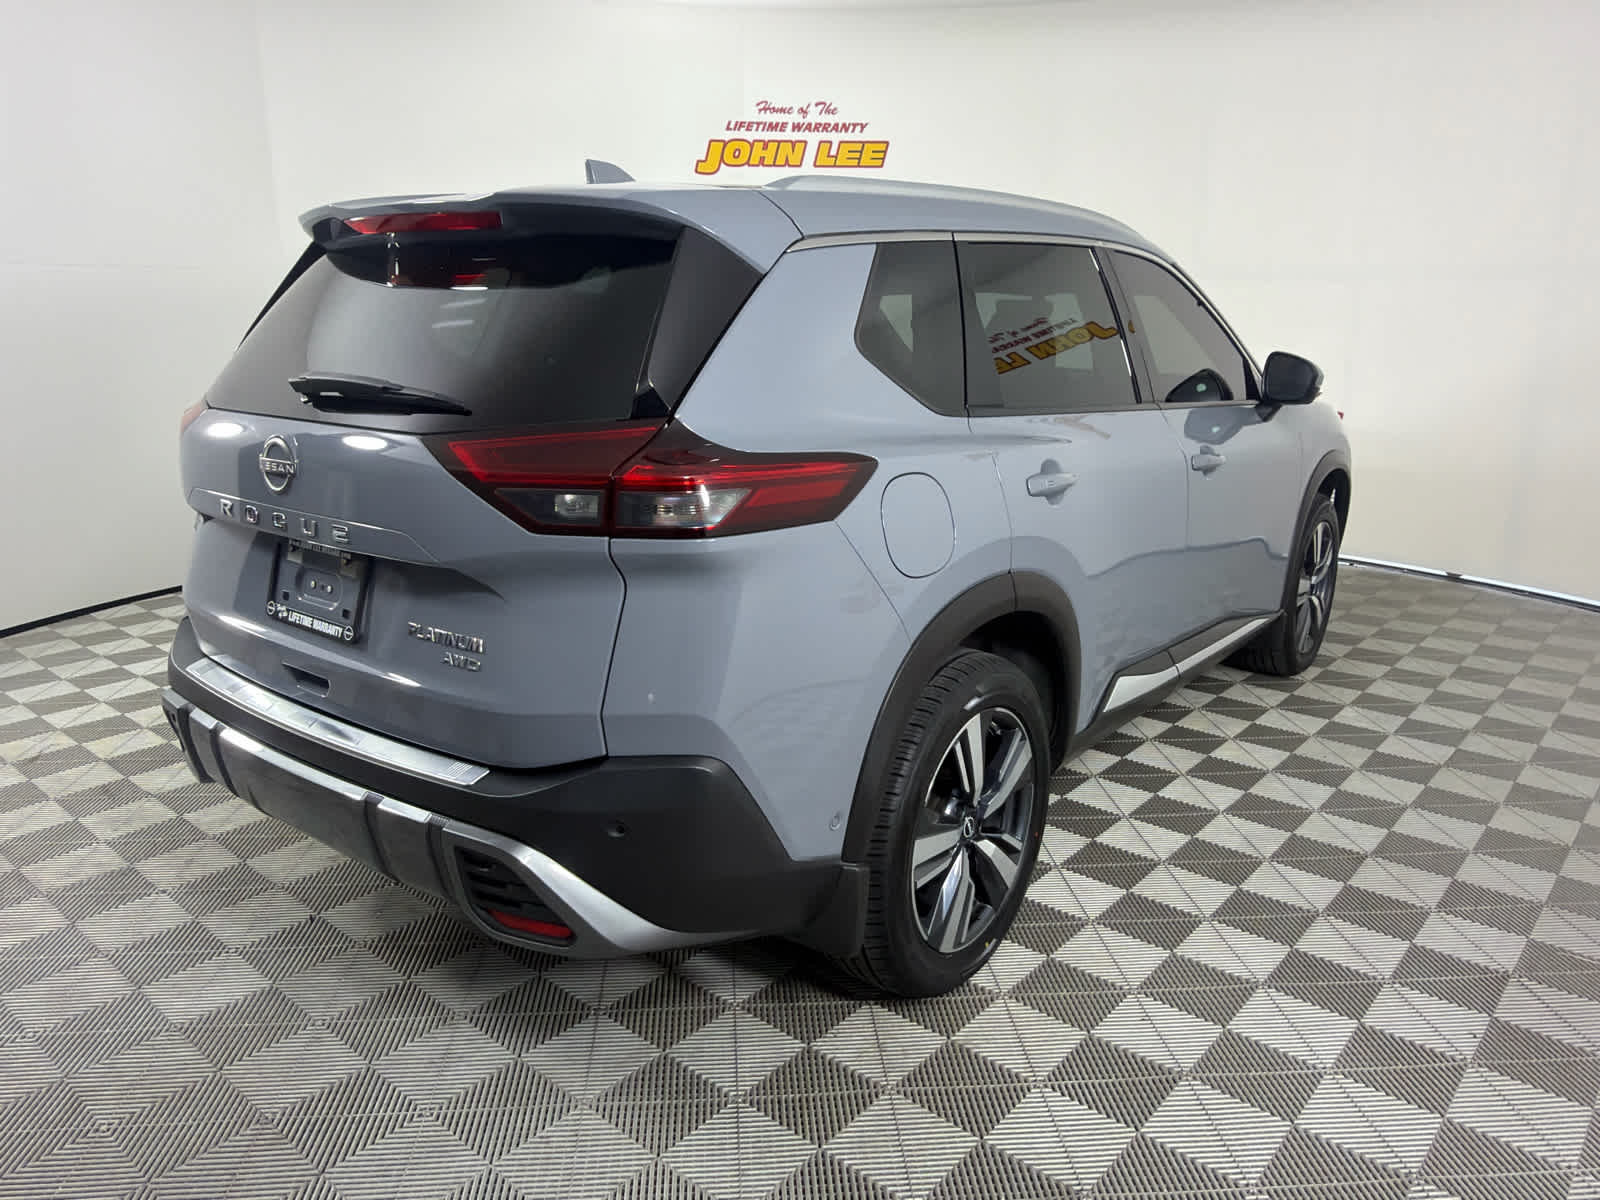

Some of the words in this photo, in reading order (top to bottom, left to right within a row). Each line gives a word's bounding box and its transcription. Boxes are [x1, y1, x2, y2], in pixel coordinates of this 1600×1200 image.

[755, 100, 794, 115] Home
[797, 103, 811, 119] of
[815, 101, 839, 116] The
[725, 120, 789, 133] LIFETIME
[791, 121, 869, 134] WARRANTY
[694, 138, 808, 175] JOHN
[813, 140, 890, 168] LEE
[259, 459, 294, 474] SSAN
[220, 498, 349, 543] ROGUE
[288, 610, 313, 628] LIFETIME
[312, 618, 343, 638] WARRANTY
[408, 620, 484, 653] PLATINUM
[441, 649, 481, 671] AWD
